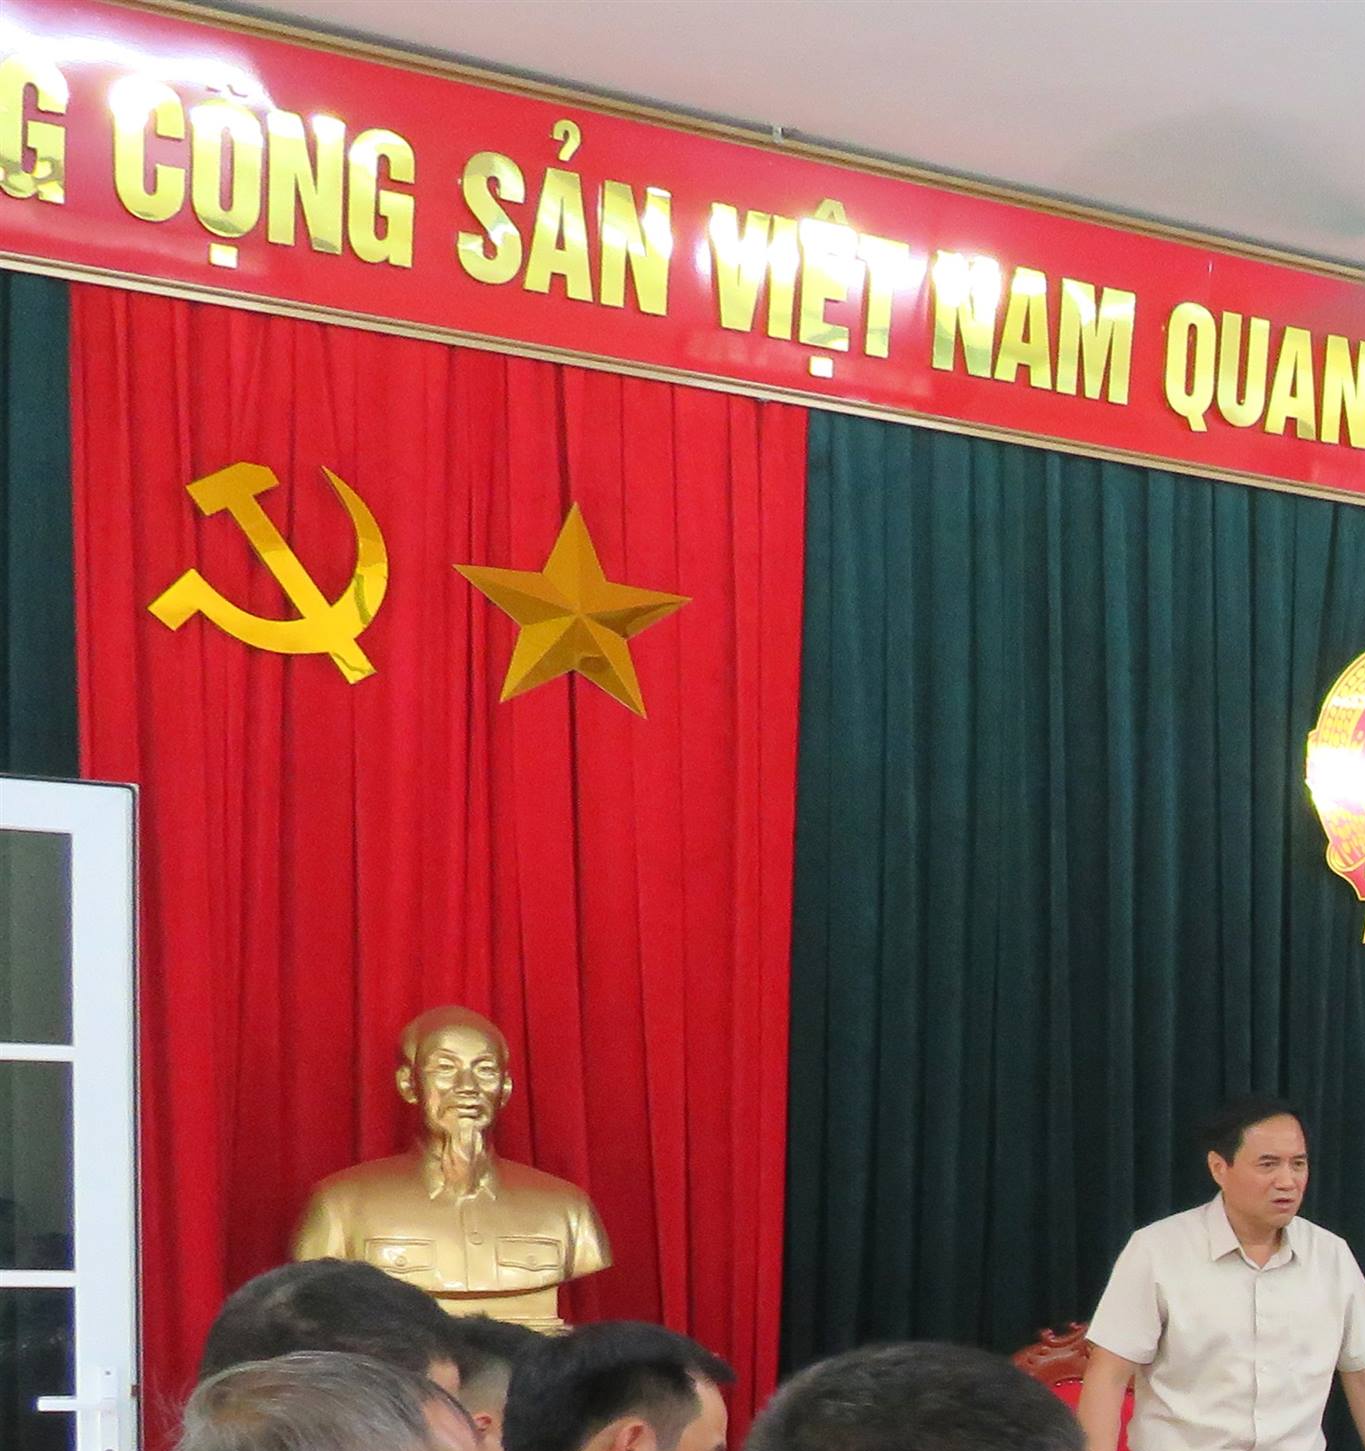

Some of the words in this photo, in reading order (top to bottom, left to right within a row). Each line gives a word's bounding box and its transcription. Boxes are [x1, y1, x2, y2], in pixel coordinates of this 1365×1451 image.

[110, 75, 416, 269] CỘNG
[457, 119, 673, 317] SẢN
[711, 199, 910, 377] VIỆT
[931, 249, 1137, 405] NAM
